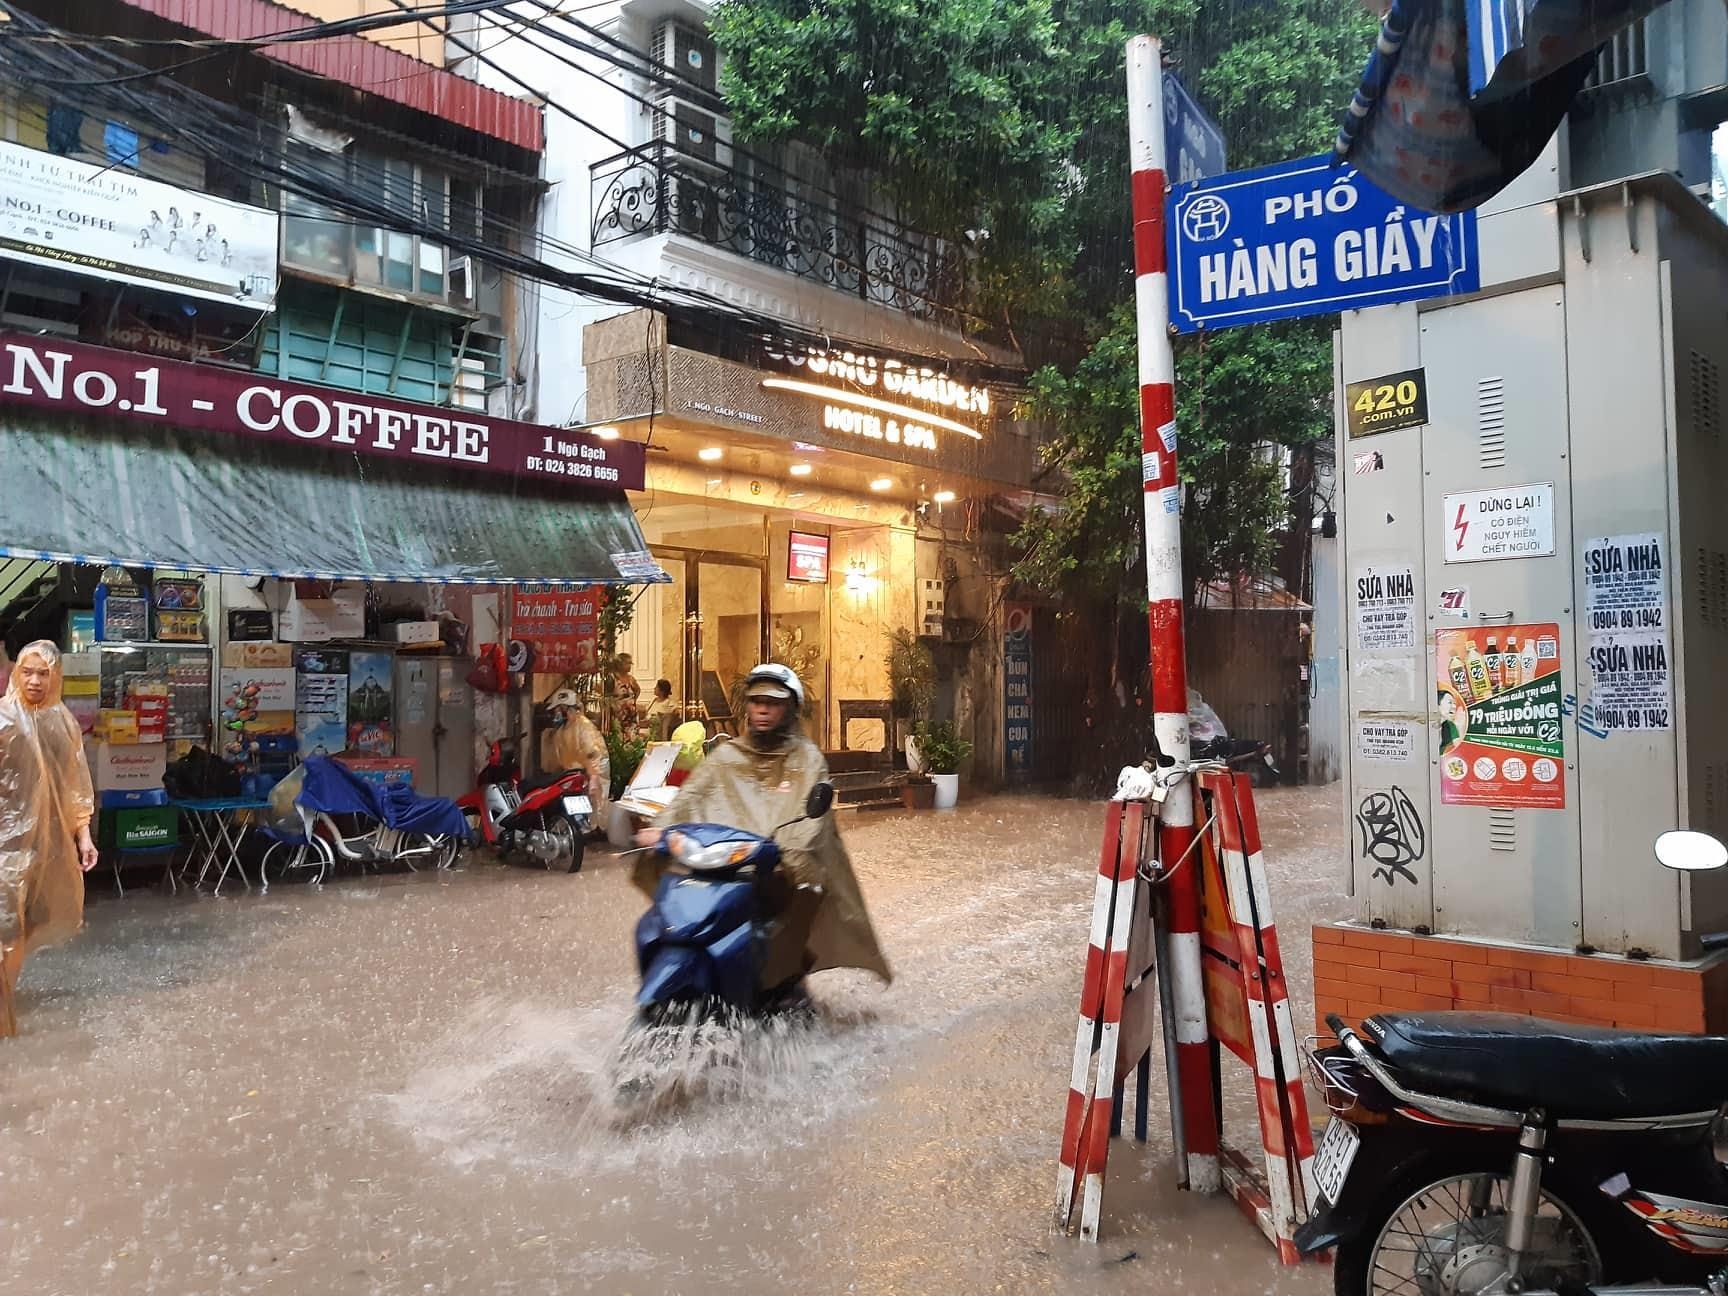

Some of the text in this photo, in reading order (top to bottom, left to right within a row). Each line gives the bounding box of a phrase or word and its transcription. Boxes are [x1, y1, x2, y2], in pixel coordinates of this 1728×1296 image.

[1264, 169, 1359, 225] PHỐ
[57, 208, 117, 232] COFFEE
[1199, 238, 1318, 303] HÀNG
[2, 344, 490, 464] No.1 - COFFEE
[1354, 380, 1418, 414] 420
[738, 411, 763, 423] STREET
[1359, 406, 1414, 425] .com.vn
[824, 405, 938, 450] HOTEL & SPA
[543, 436, 606, 462] 1 Ngõ Gạch
[527, 456, 619, 482] ĐT: 024 3826 6656
[1480, 496, 1512, 512] DỪNG
[1516, 496, 1534, 511] LẠI
[1507, 515, 1530, 527] ĐIỆN
[1484, 530, 1511, 541] NGUY
[1482, 538, 1540, 554] CHẾT NGƯỜI
[1592, 537, 1662, 574] SỬA NHÀ
[1358, 567, 1415, 600] SỬA NHÀ
[1593, 608, 1662, 630] 0904 89 1942
[1486, 655, 1499, 670] C2
[1505, 655, 1518, 669] C2
[1597, 636, 1667, 673] SỬA NHÀ
[1453, 671, 1465, 682] C2
[1471, 666, 1484, 679] C2
[1540, 681, 1556, 694] GIÁ
[1007, 705, 1029, 719] NEM
[1469, 697, 1559, 726] 79 TRIỆU ĐỒNG
[1627, 709, 1640, 728] 89
[1642, 708, 1669, 728] 1942
[1008, 726, 1028, 741] CUA
[1362, 727, 1373, 736] CHO
[1374, 727, 1384, 736] VAY
[1498, 724, 1517, 735] NGÀY
[1518, 723, 1534, 735] VỚI
[1539, 722, 1559, 742] C2
